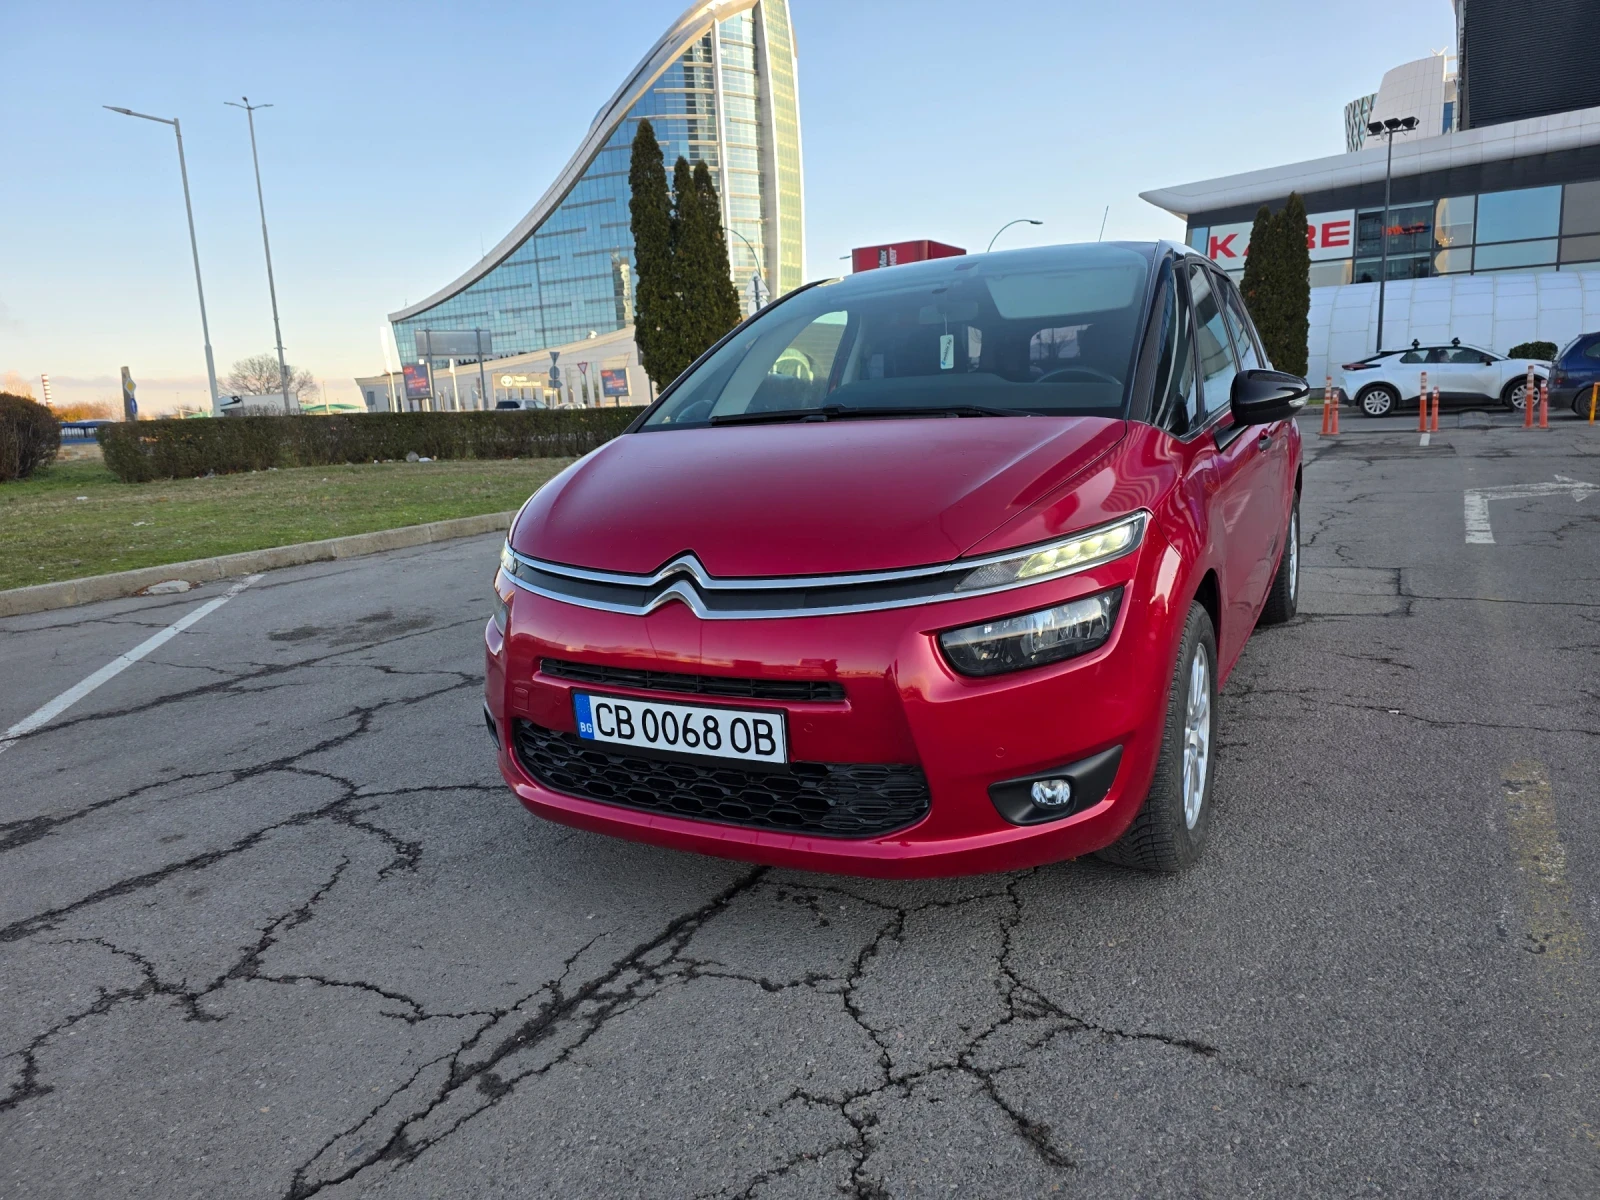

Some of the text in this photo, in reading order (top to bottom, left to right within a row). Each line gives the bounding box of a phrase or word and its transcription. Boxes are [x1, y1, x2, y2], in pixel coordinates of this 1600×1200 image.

[1210, 220, 1351, 260] KE
[580, 721, 593, 733] BG
[595, 702, 635, 740] CB
[641, 708, 722, 750] 0068
